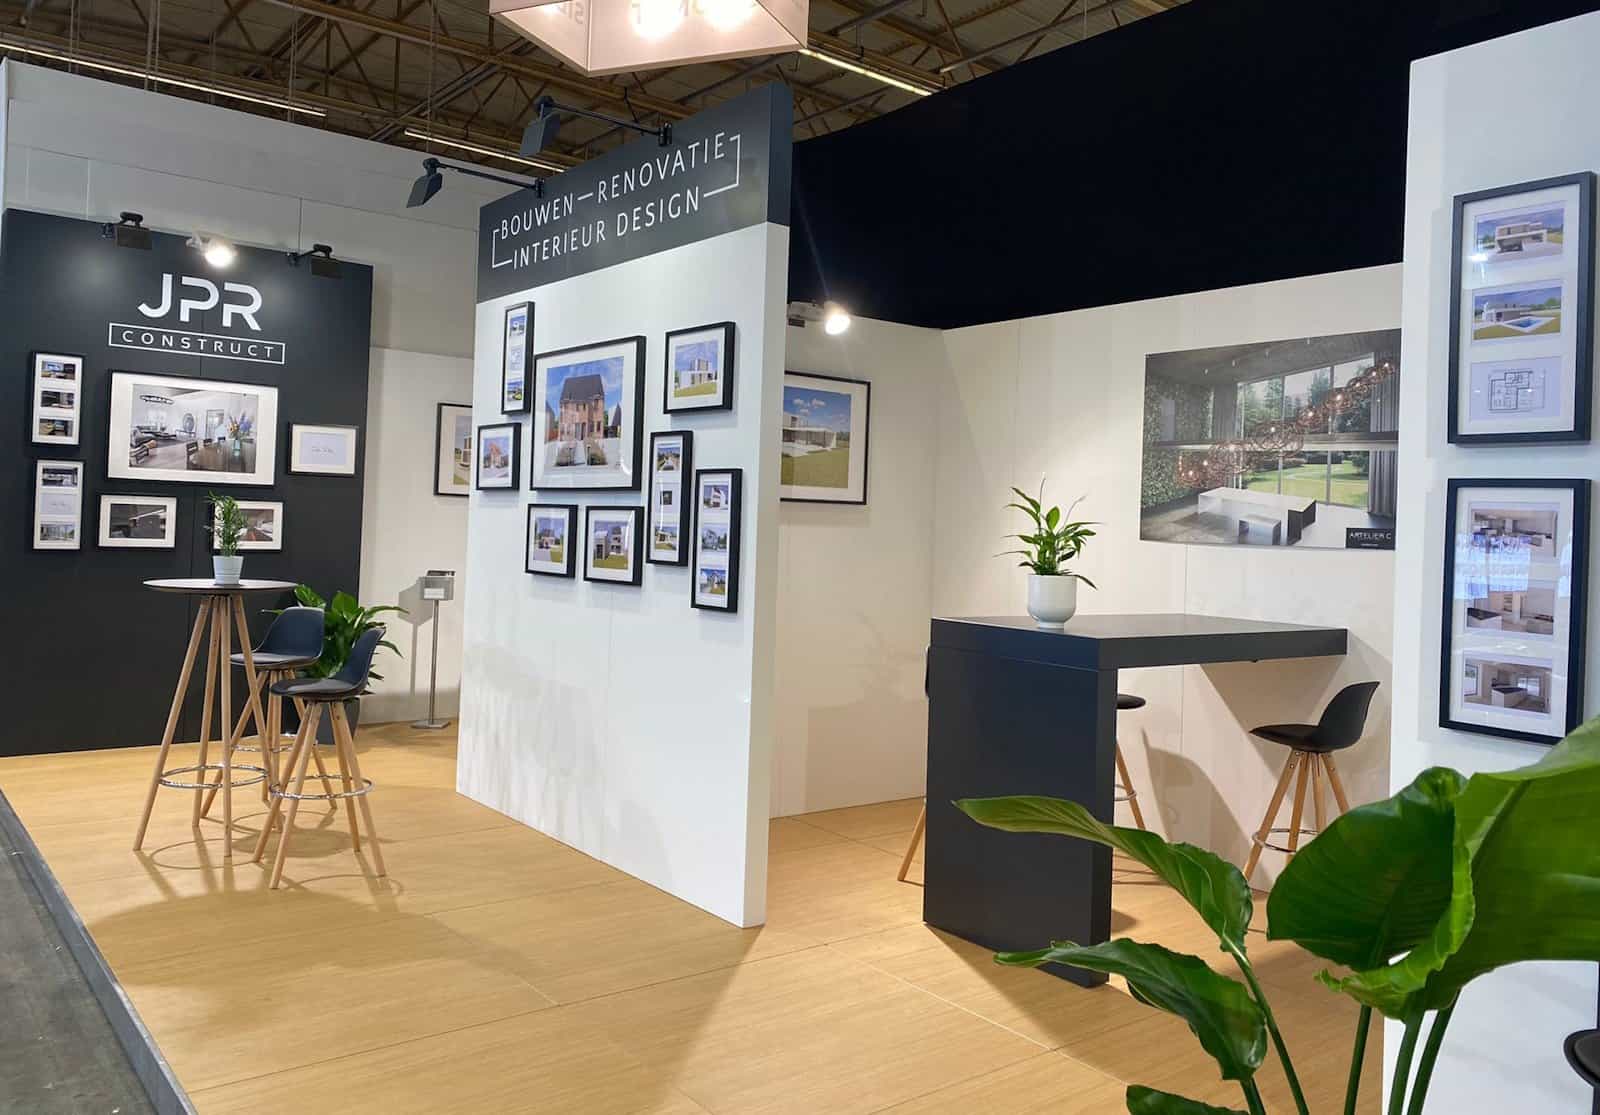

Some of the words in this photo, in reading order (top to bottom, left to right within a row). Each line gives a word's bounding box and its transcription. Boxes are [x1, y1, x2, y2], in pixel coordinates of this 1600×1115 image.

[501, 193, 574, 240] BOUWEN
[598, 131, 726, 204] RENOVATIE
[513, 220, 607, 270] INTERIEUR
[616, 186, 700, 237] DESIGN
[138, 273, 262, 331] JPR
[122, 330, 274, 358] CONSTRUCT
